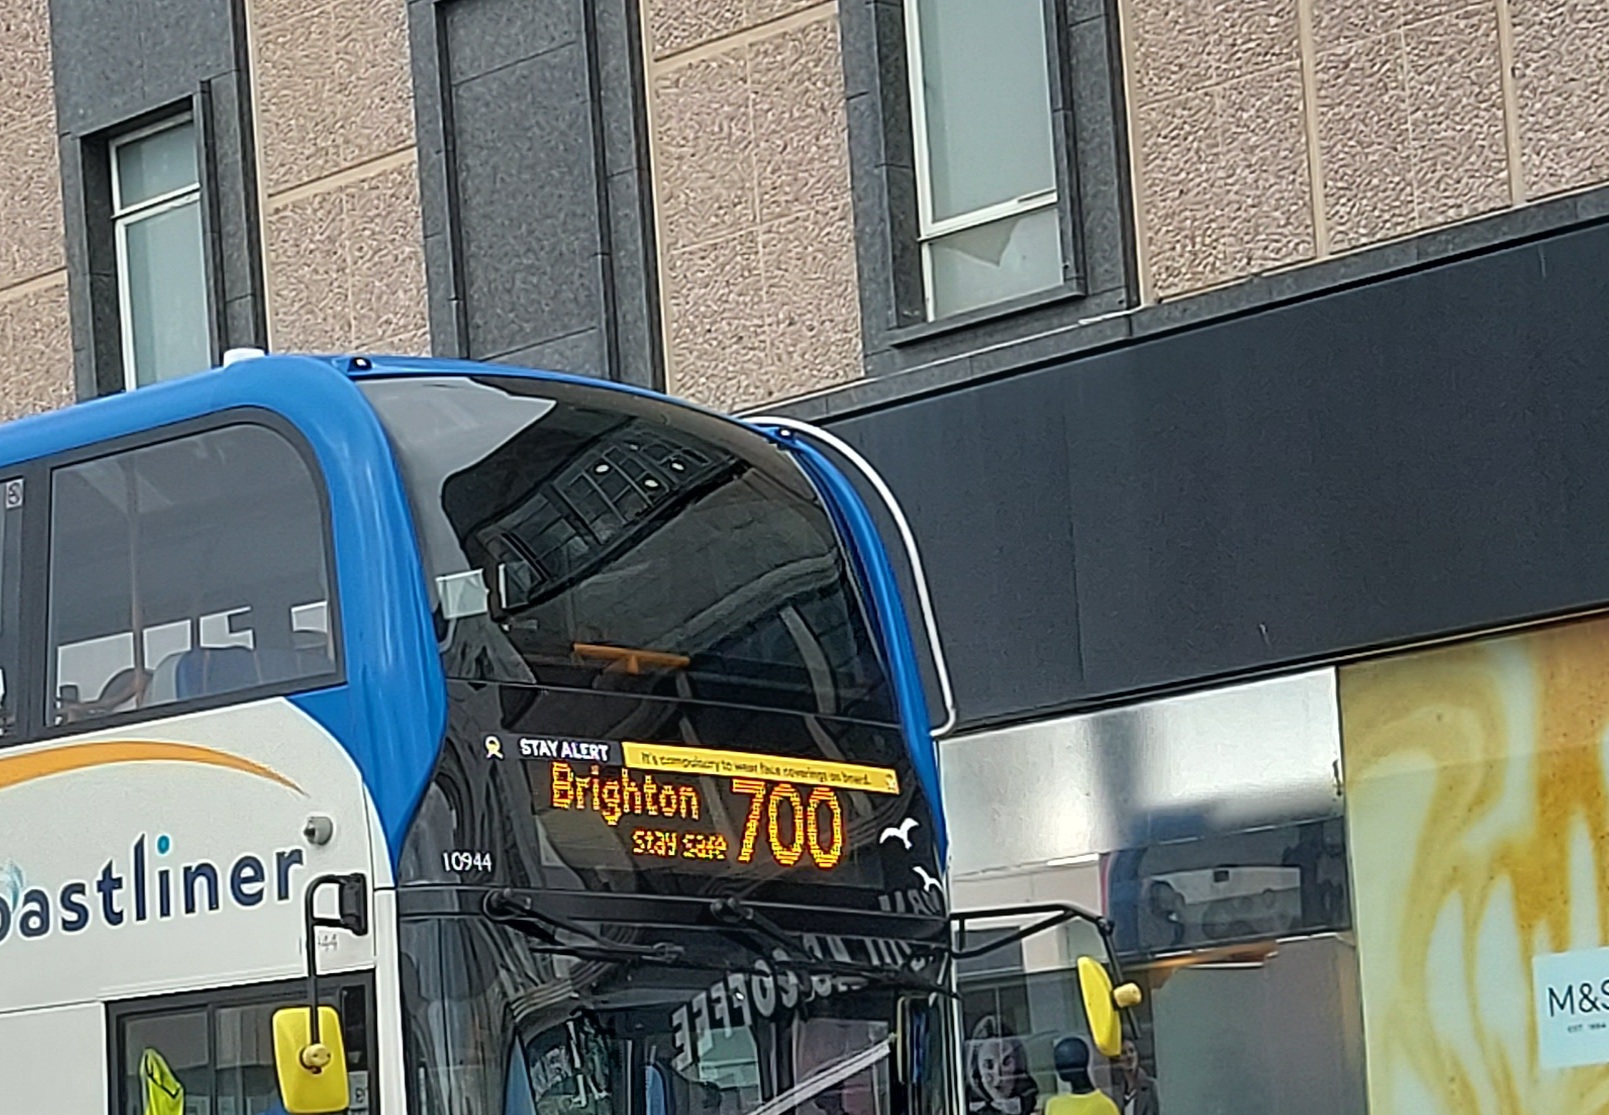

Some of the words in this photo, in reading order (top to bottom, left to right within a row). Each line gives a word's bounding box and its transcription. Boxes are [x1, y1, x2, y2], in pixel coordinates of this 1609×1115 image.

[519, 738, 558, 758] STAY
[560, 741, 609, 762] ALERT
[551, 760, 700, 827] Brighton
[731, 777, 843, 869] 700
[443, 851, 493, 873] 10944
